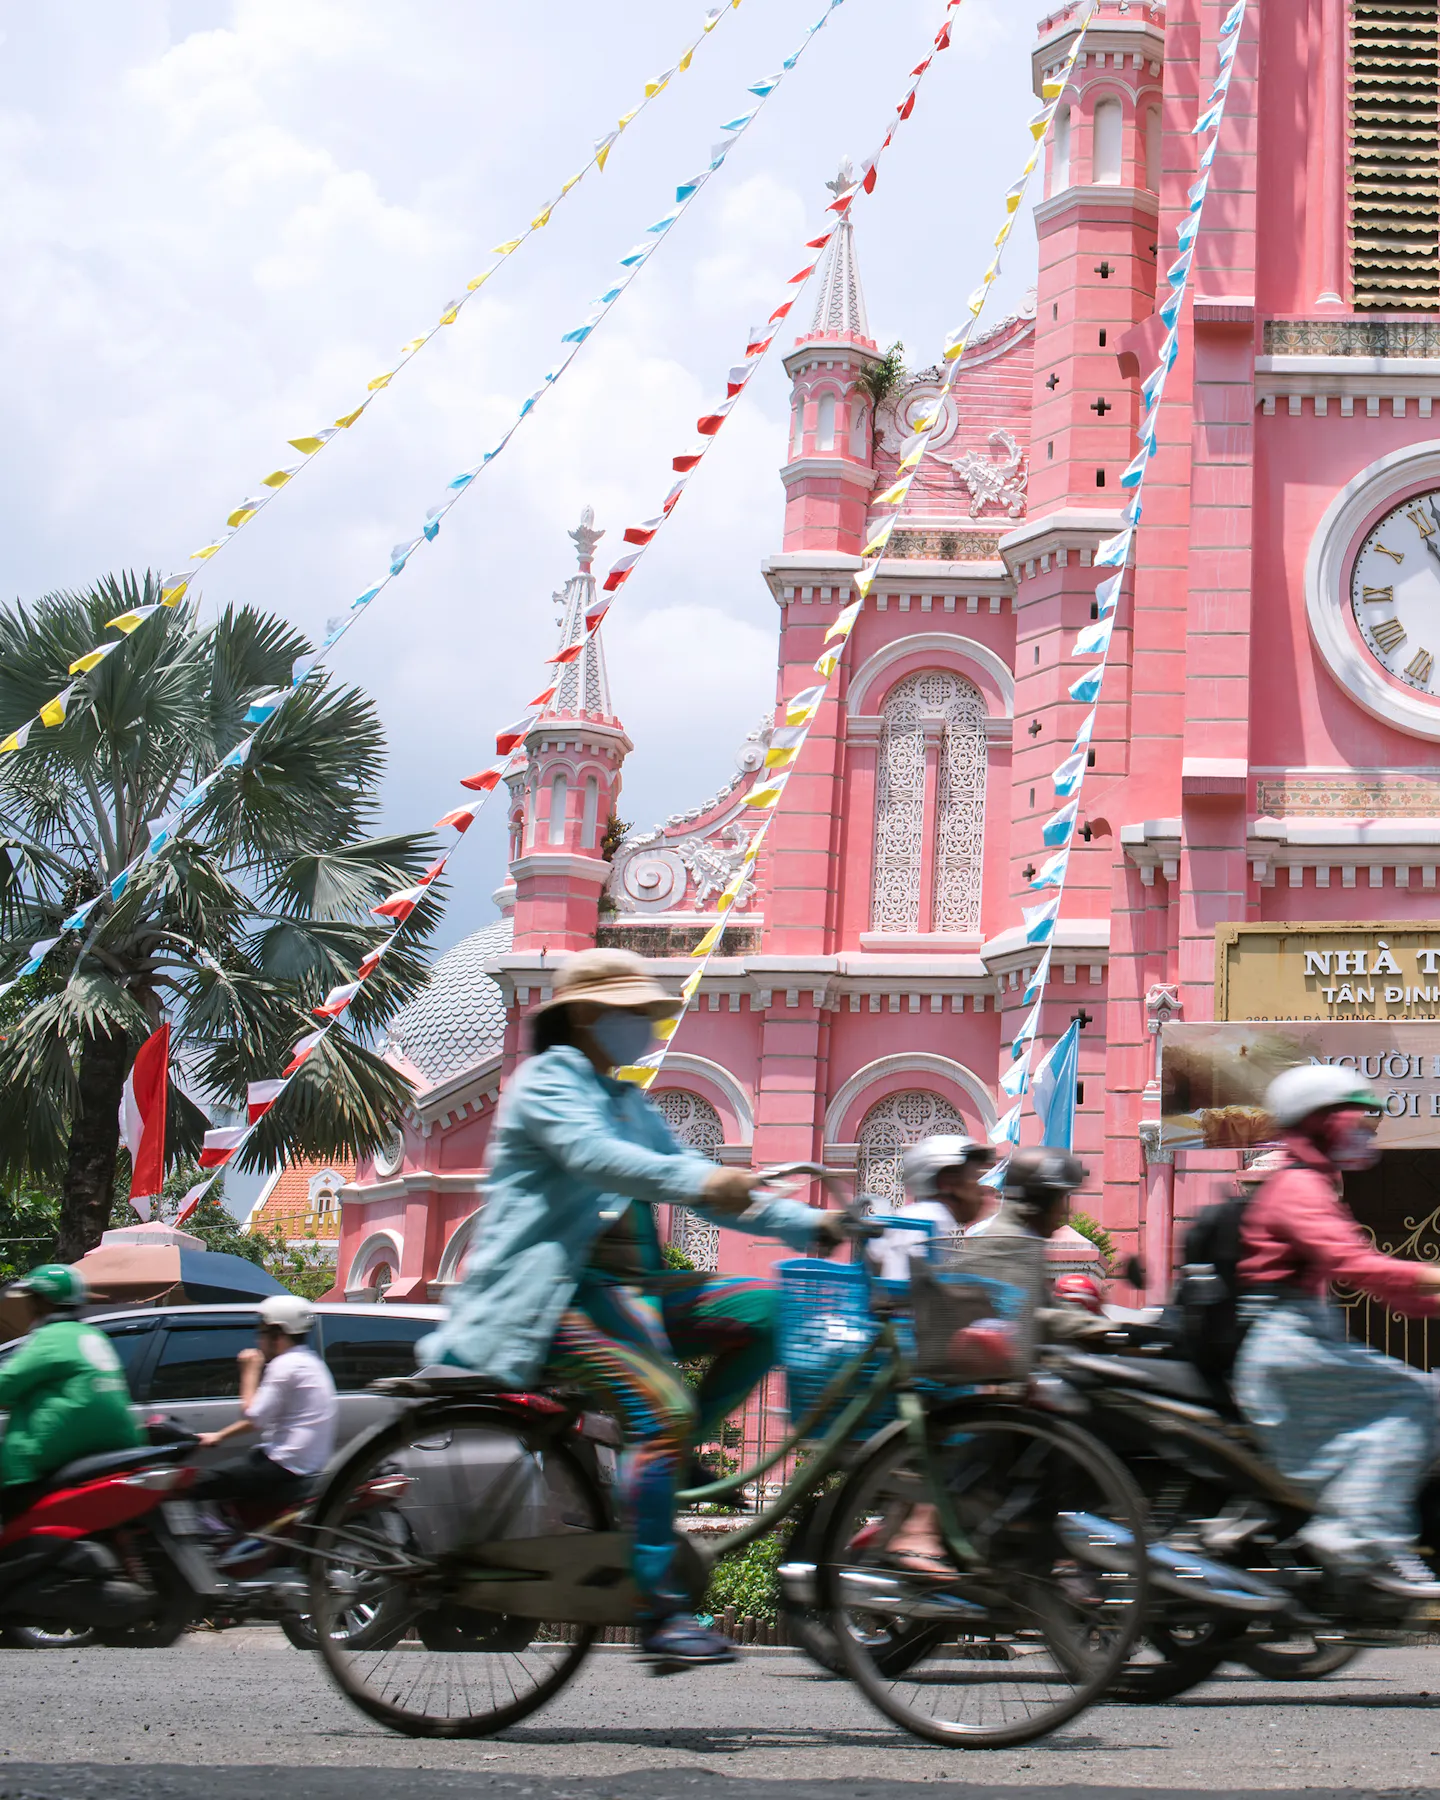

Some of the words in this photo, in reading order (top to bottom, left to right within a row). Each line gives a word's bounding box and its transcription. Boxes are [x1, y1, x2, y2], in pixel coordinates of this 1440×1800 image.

[1406, 507, 1436, 538] XI
[1374, 541, 1404, 564] X
[1363, 584, 1393, 604] IX
[1370, 616, 1407, 654] VIII
[1404, 647, 1434, 682] VII
[1303, 941, 1402, 976] NHÀ
[1322, 983, 1375, 1004] TÂN
[1364, 1088, 1420, 1117] ỜI
